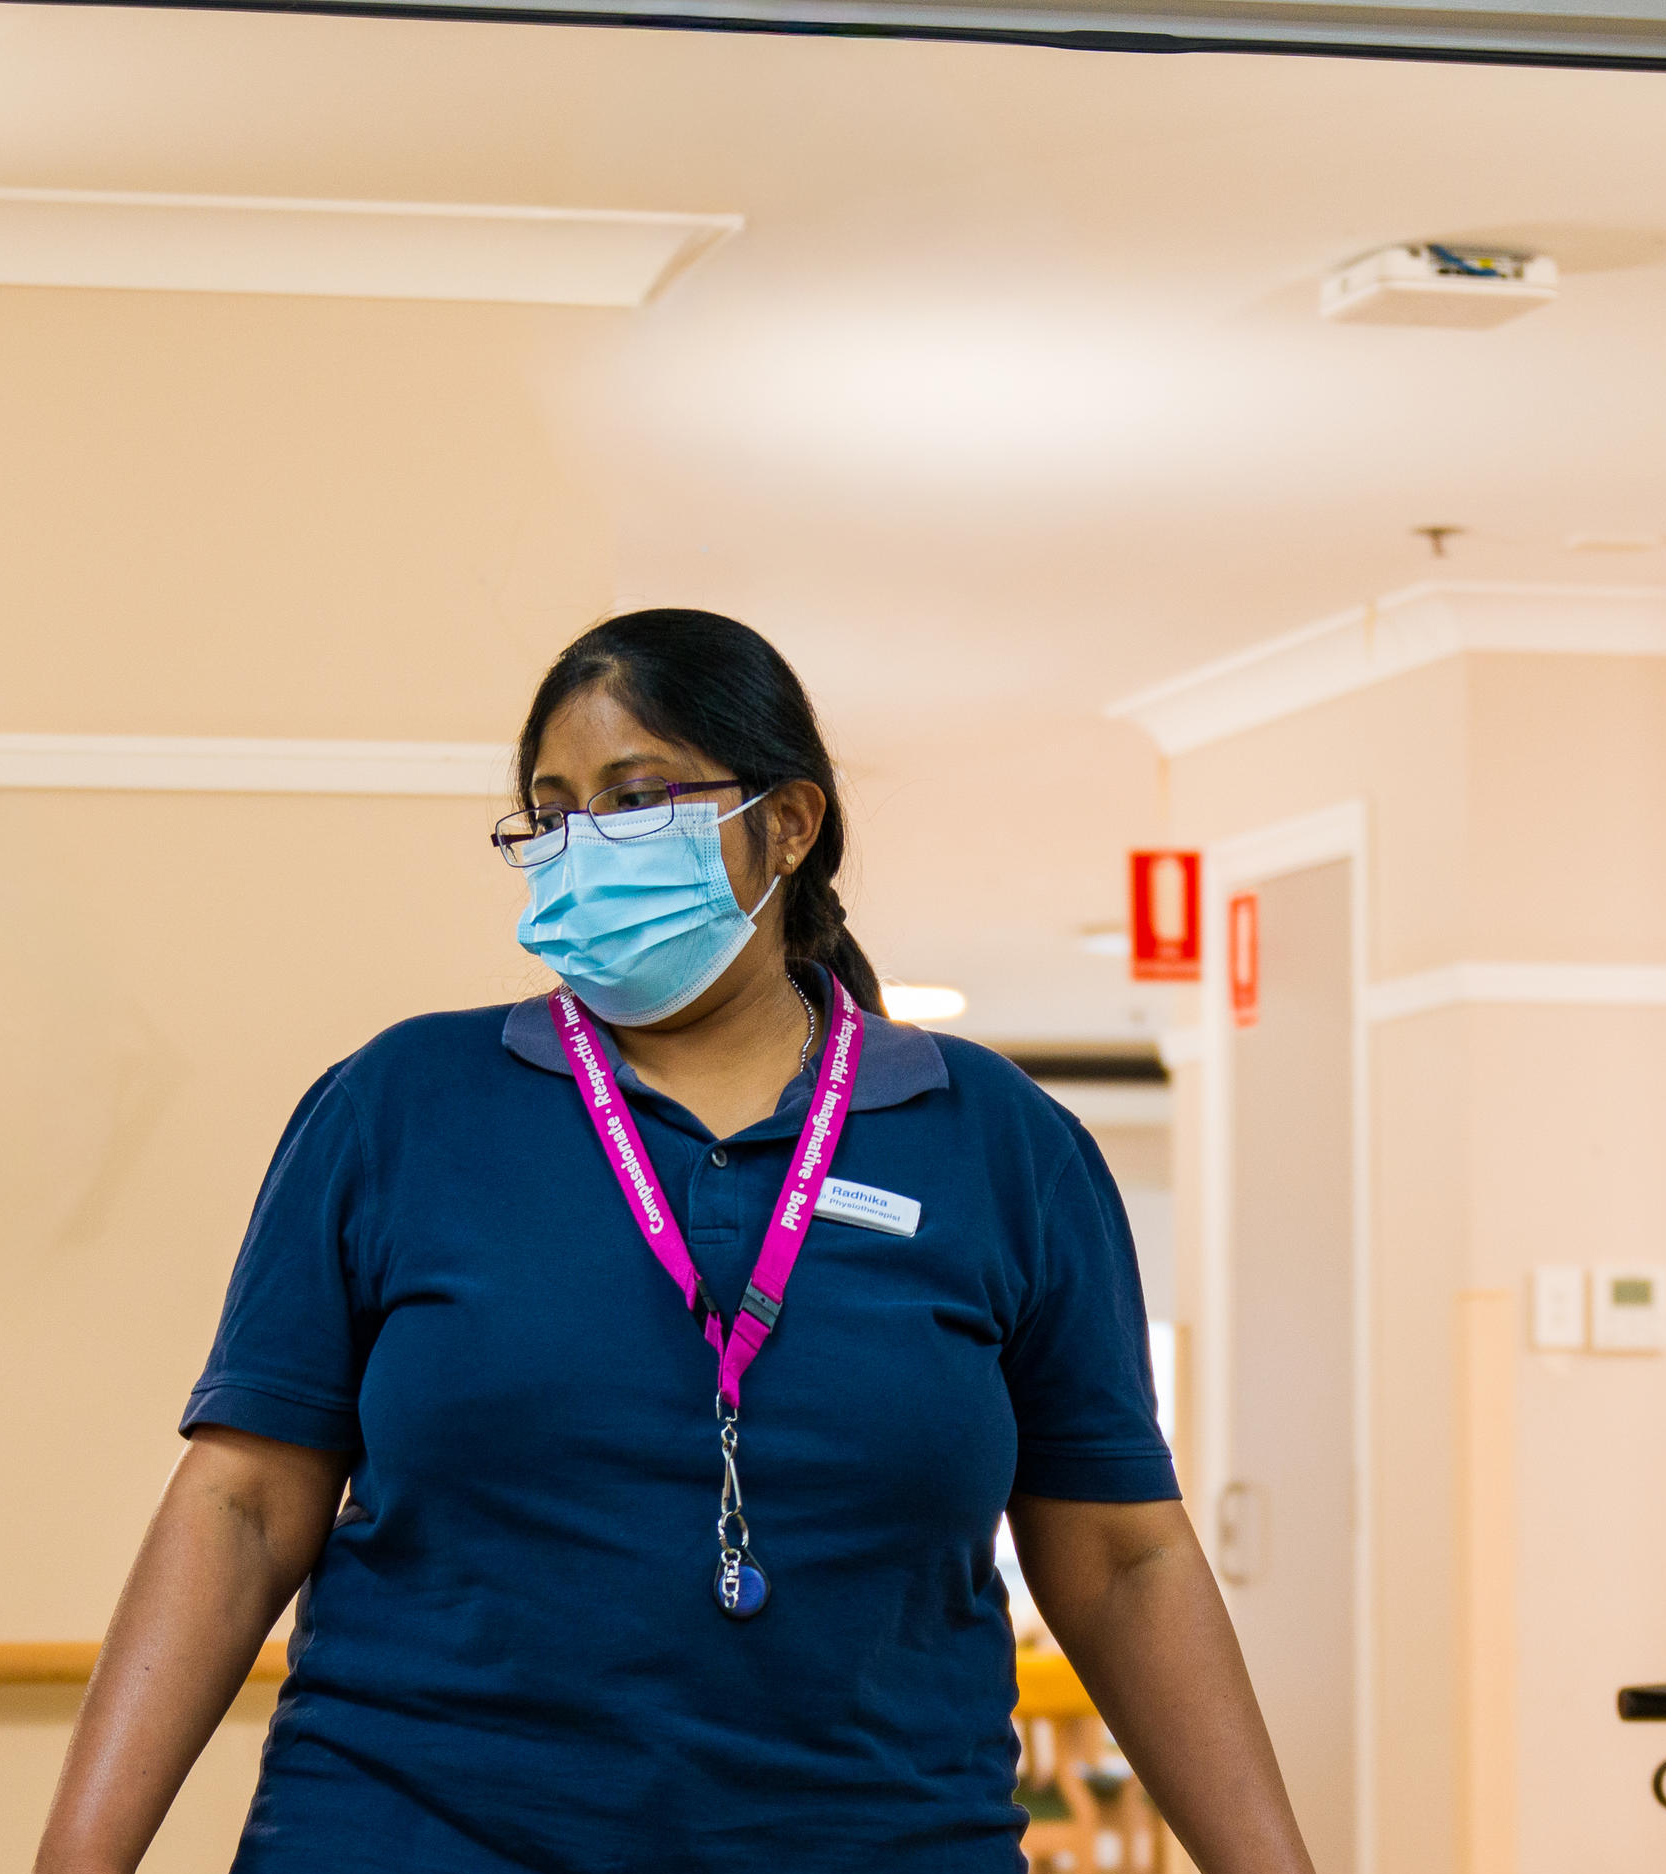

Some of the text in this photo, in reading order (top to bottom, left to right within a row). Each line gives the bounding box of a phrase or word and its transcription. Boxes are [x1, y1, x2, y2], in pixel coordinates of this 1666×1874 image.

[569, 1031, 612, 1109] Respectful
[829, 1018, 857, 1085] Respectful
[798, 1090, 841, 1180] Imaginative
[607, 1115, 664, 1235] Compassionate
[832, 1186, 888, 1208] Radhika
[781, 1189, 808, 1232] Bold
[829, 1198, 901, 1221] Physiotherapist
